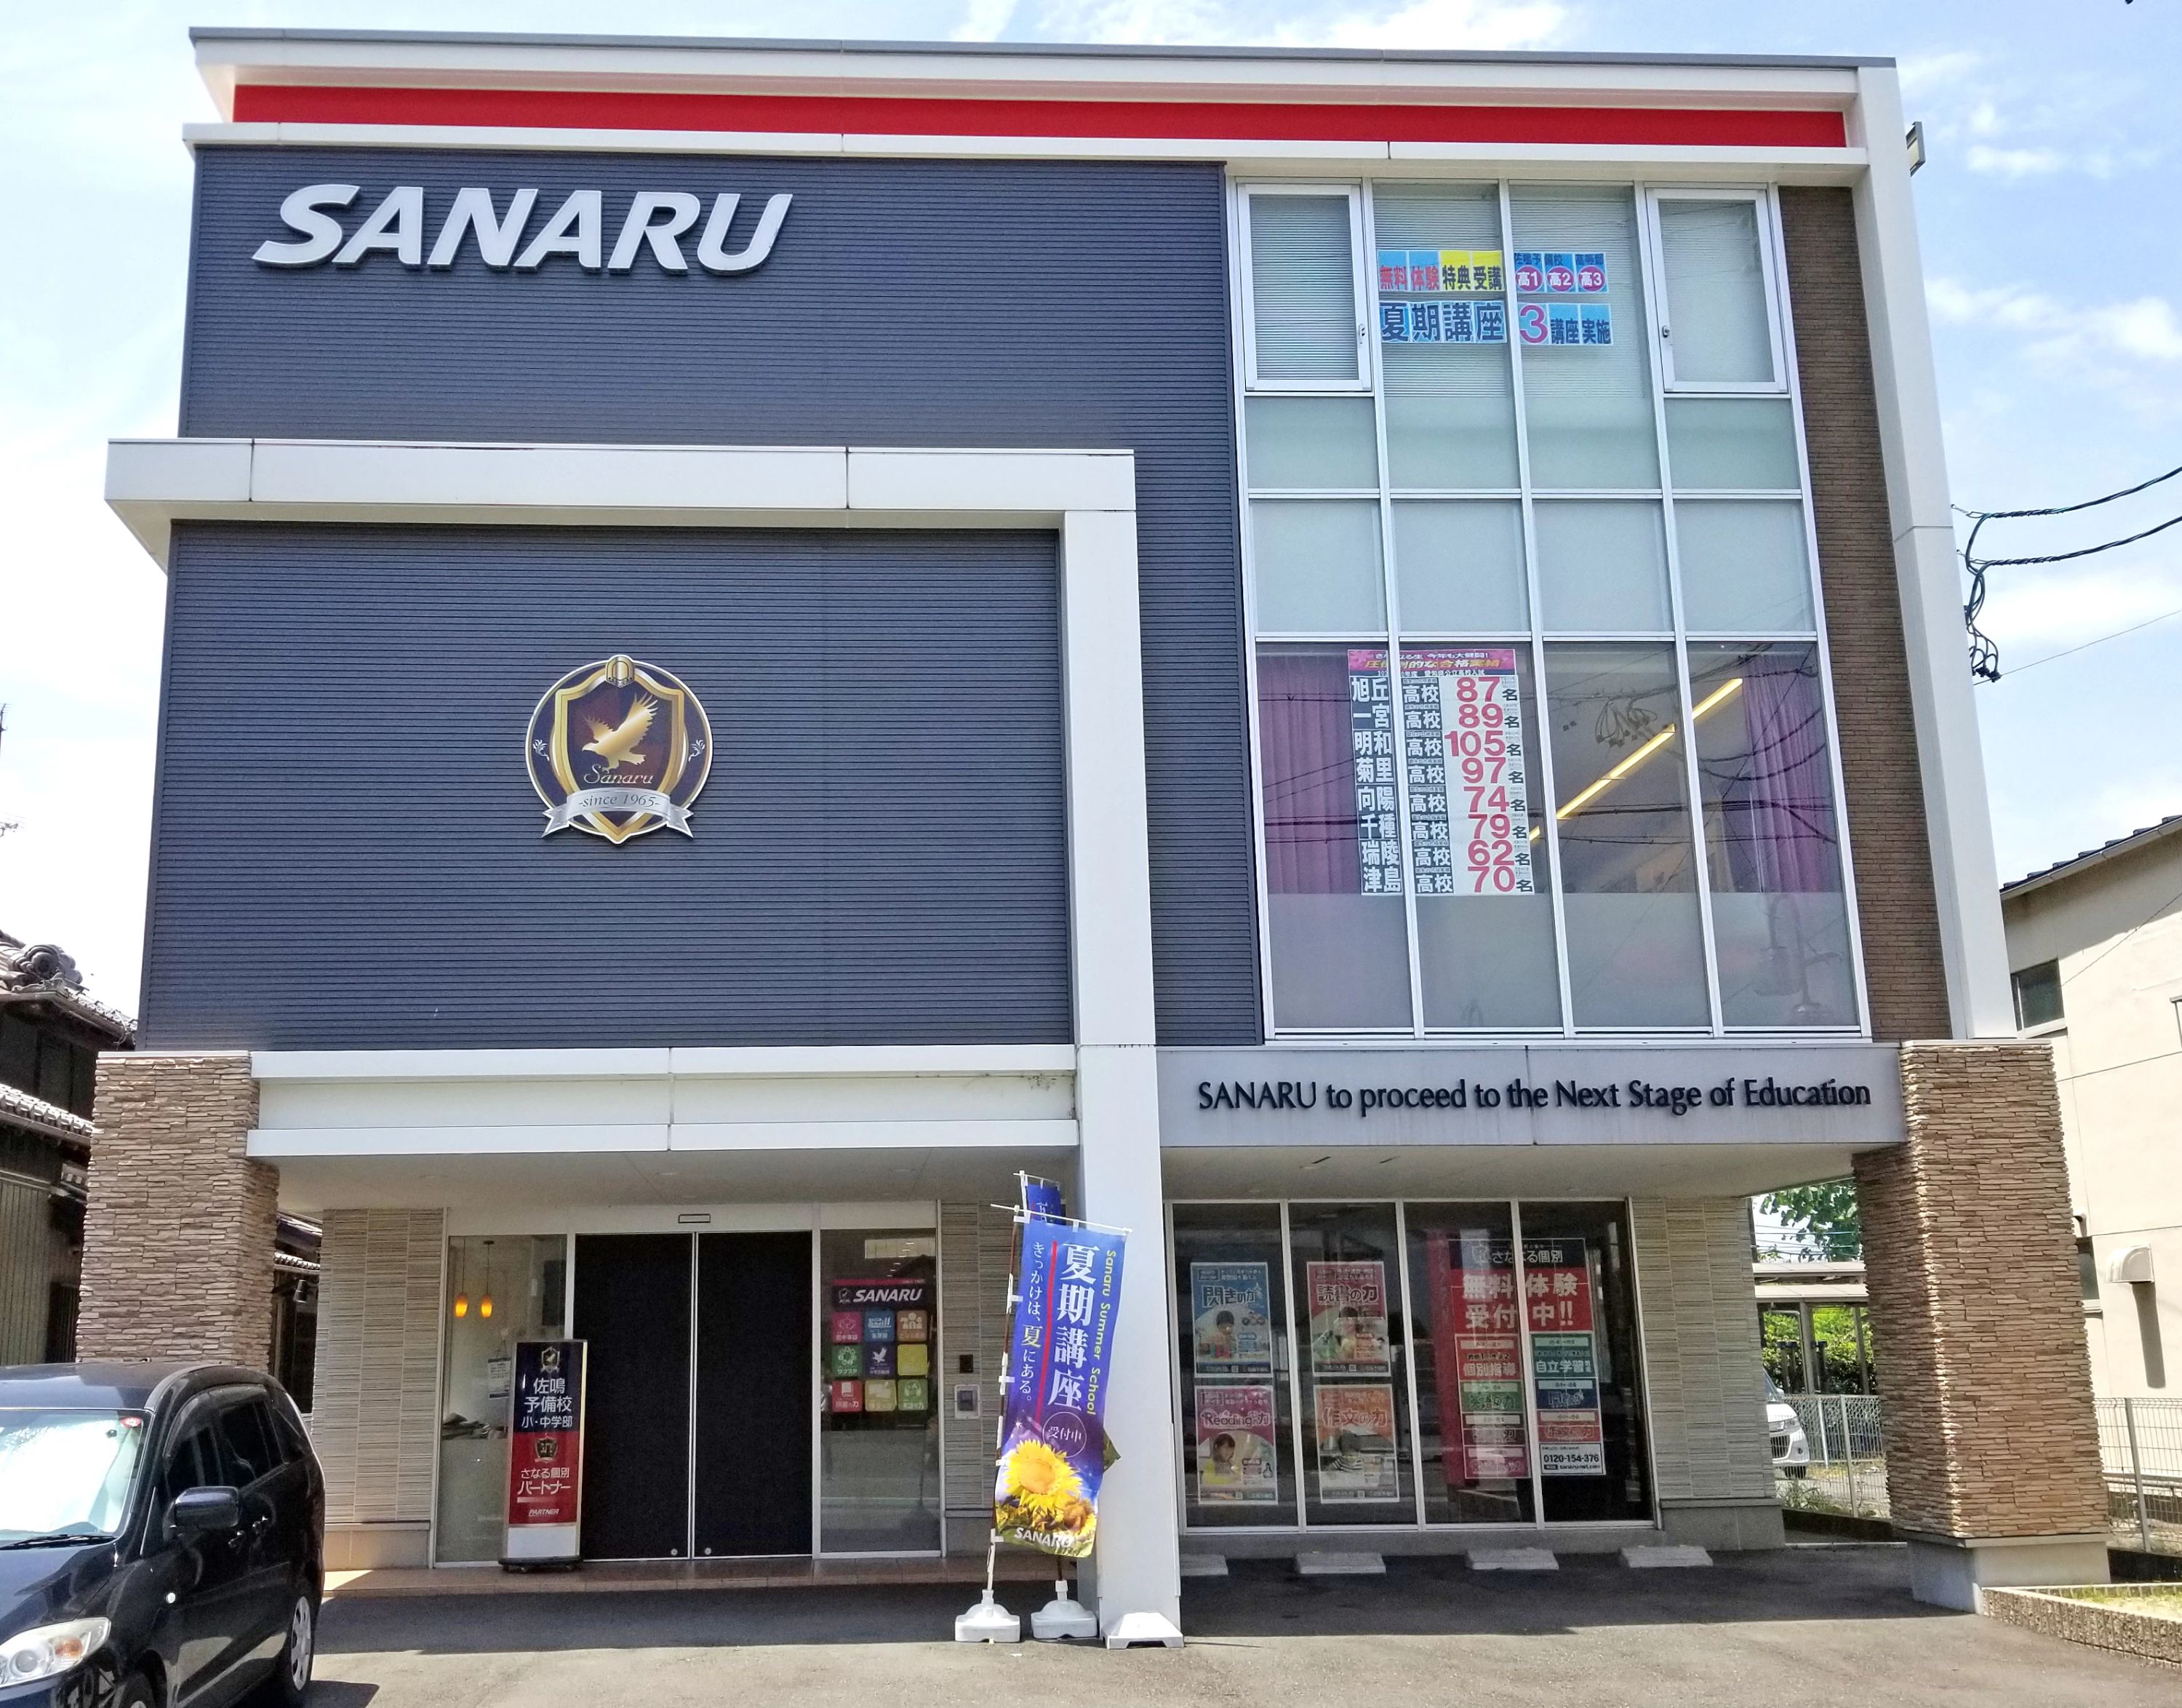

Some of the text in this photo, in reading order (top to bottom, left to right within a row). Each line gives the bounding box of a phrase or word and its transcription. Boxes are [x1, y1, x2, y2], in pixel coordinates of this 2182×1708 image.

[251, 184, 793, 272] SANARU
[1379, 265, 1503, 290] 無料体験 特典受講
[1516, 271, 1602, 286] 高1 高2 高3
[1380, 302, 1504, 342] 夏期講座
[1351, 677, 1389, 703] 旭丘
[1402, 685, 1439, 703] 高校
[1353, 703, 1391, 728] 一宮
[1404, 711, 1441, 729] 高校
[1354, 730, 1392, 756] 明和
[1407, 738, 1442, 757] 高校
[583, 764, 655, 784] Sanaru
[1356, 757, 1394, 783] 菊里
[1408, 765, 1444, 784] 高校
[1358, 786, 1395, 812] 向陽
[1410, 794, 1447, 813] 高校
[1361, 813, 1396, 839] 千種
[1412, 821, 1448, 839] 高校
[1361, 840, 1400, 866] 瑞陵
[1414, 847, 1451, 866] 高校
[1363, 866, 1401, 893] 津島
[1415, 874, 1453, 893] 高校
[1198, 1077, 1873, 1118] SANARU to proceed to the Next Stage of Education
[853, 1288, 923, 1303] SANARU
[1463, 1273, 1578, 1299] 無料体験
[1047, 1242, 1100, 1411] 夏期講座
[1087, 1249, 1116, 1415] Sanaru Summer School
[532, 1377, 566, 1394] 佐鳴
[524, 1395, 572, 1413] 予備校
[1322, 1407, 1388, 1427] 作文の力
[1047, 1425, 1082, 1442] 受付中
[1543, 1453, 1599, 1463] 0120-154-376
[520, 1467, 570, 1479] さなる個別
[517, 1480, 571, 1495] パートナー
[528, 1508, 559, 1517] PARTNER
